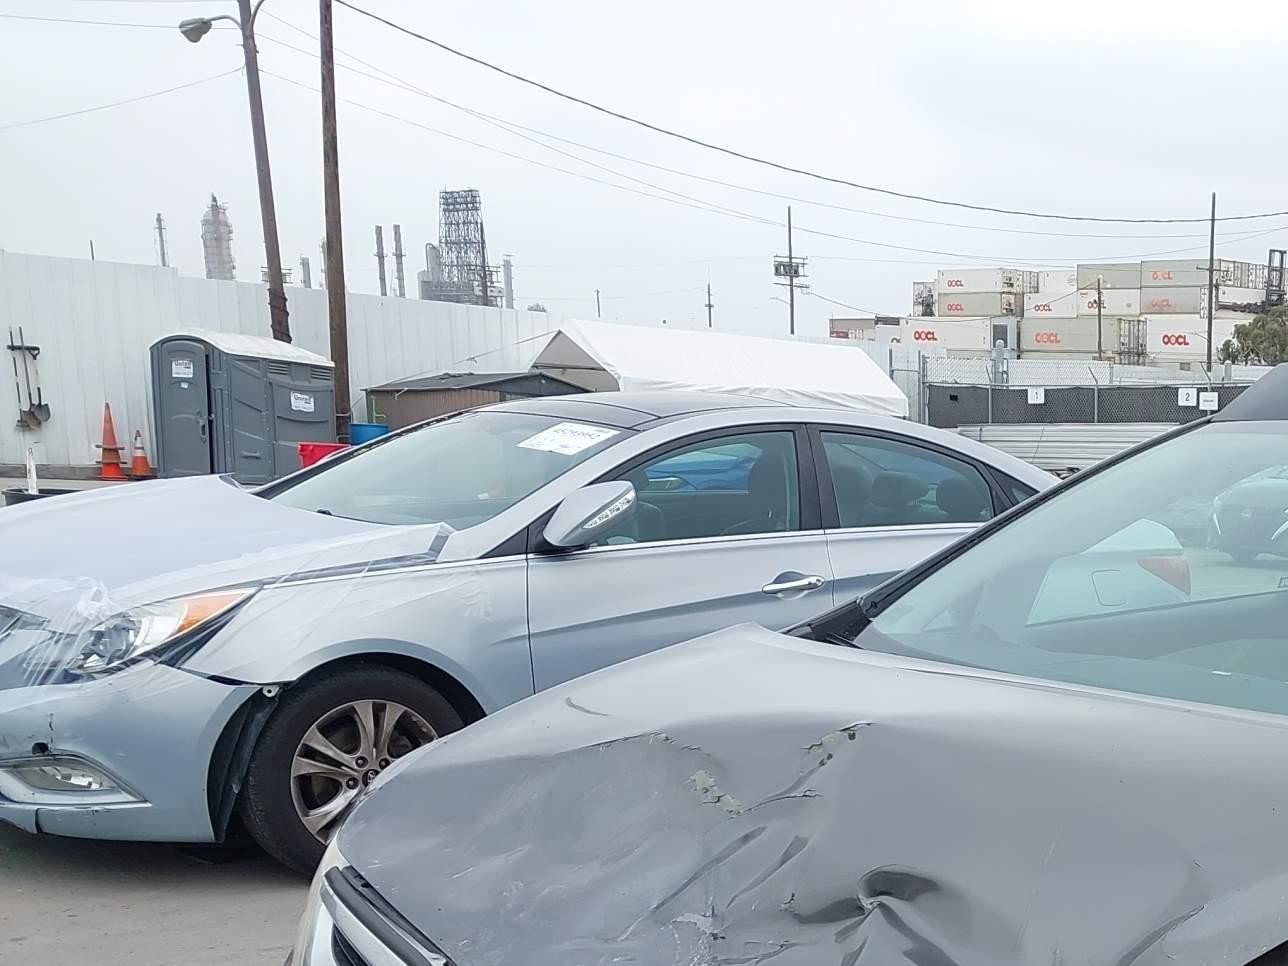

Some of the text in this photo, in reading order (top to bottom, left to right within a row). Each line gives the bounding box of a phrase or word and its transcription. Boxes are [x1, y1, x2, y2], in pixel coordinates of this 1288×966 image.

[946, 279, 965, 288] OOCL
[946, 303, 965, 312] OOCL
[1034, 304, 1053, 312] OOCL
[1087, 301, 1107, 310] OOL
[913, 330, 938, 341] OOCL
[1034, 332, 1061, 344] OOCL
[1162, 334, 1190, 346] OOCL
[1184, 392, 1191, 401] 2
